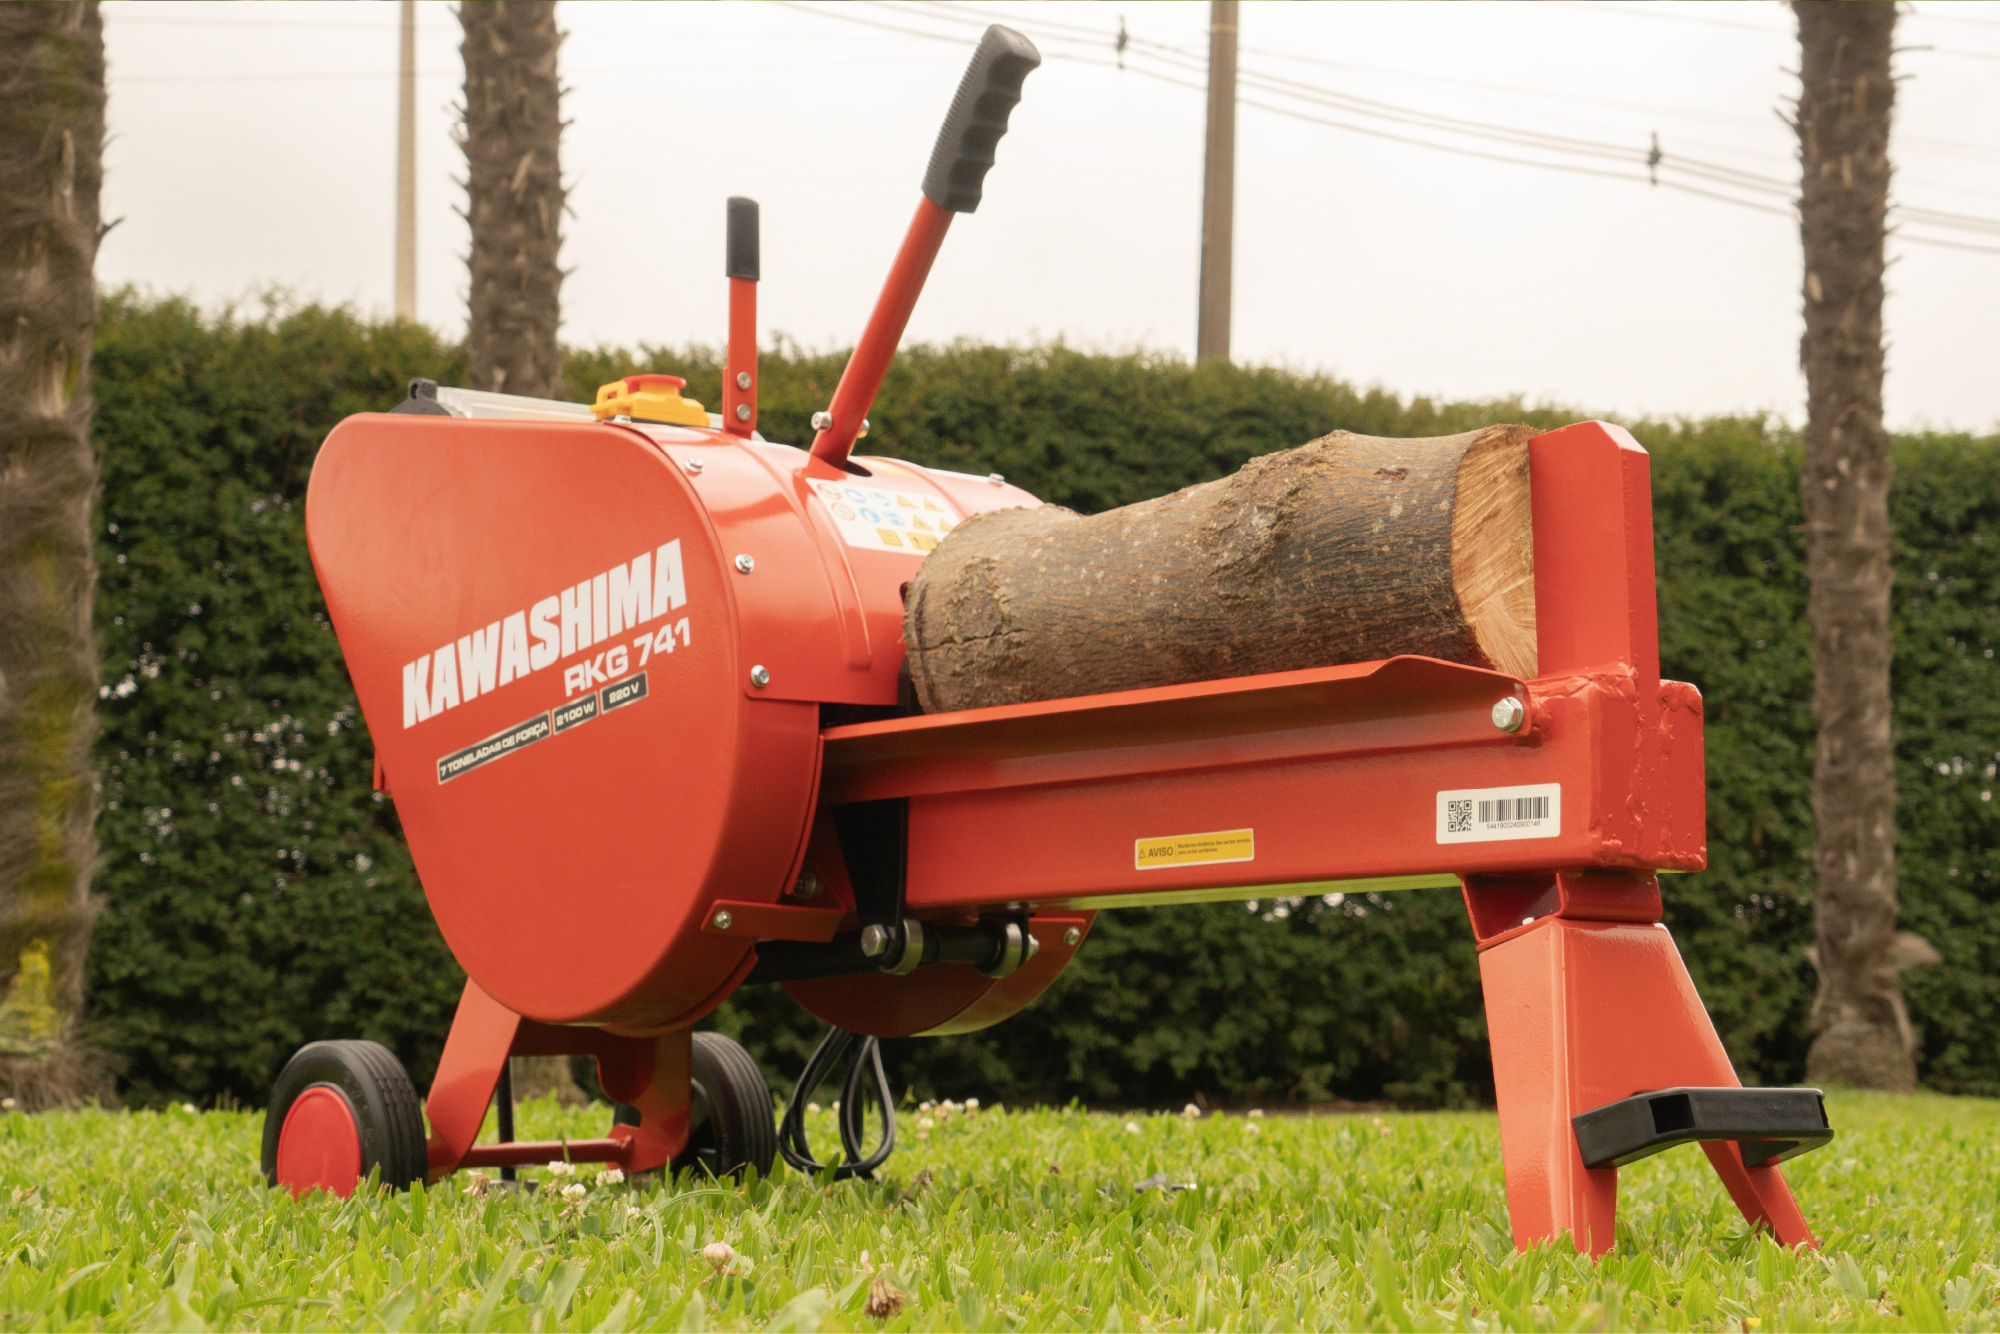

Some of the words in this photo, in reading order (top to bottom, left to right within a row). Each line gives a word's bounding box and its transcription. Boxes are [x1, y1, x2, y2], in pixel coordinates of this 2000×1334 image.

[402, 537, 687, 730] KAWASHIMA
[564, 644, 629, 698] RKG
[633, 616, 691, 668] 741
[608, 686, 631, 704] 220
[631, 681, 640, 695] V
[556, 706, 583, 727] 2100
[440, 764, 447, 777] 7
[447, 741, 502, 773] TONELADAS
[502, 735, 516, 748] DE
[515, 721, 549, 744] FORÇA
[1148, 846, 1174, 858] AVISO
